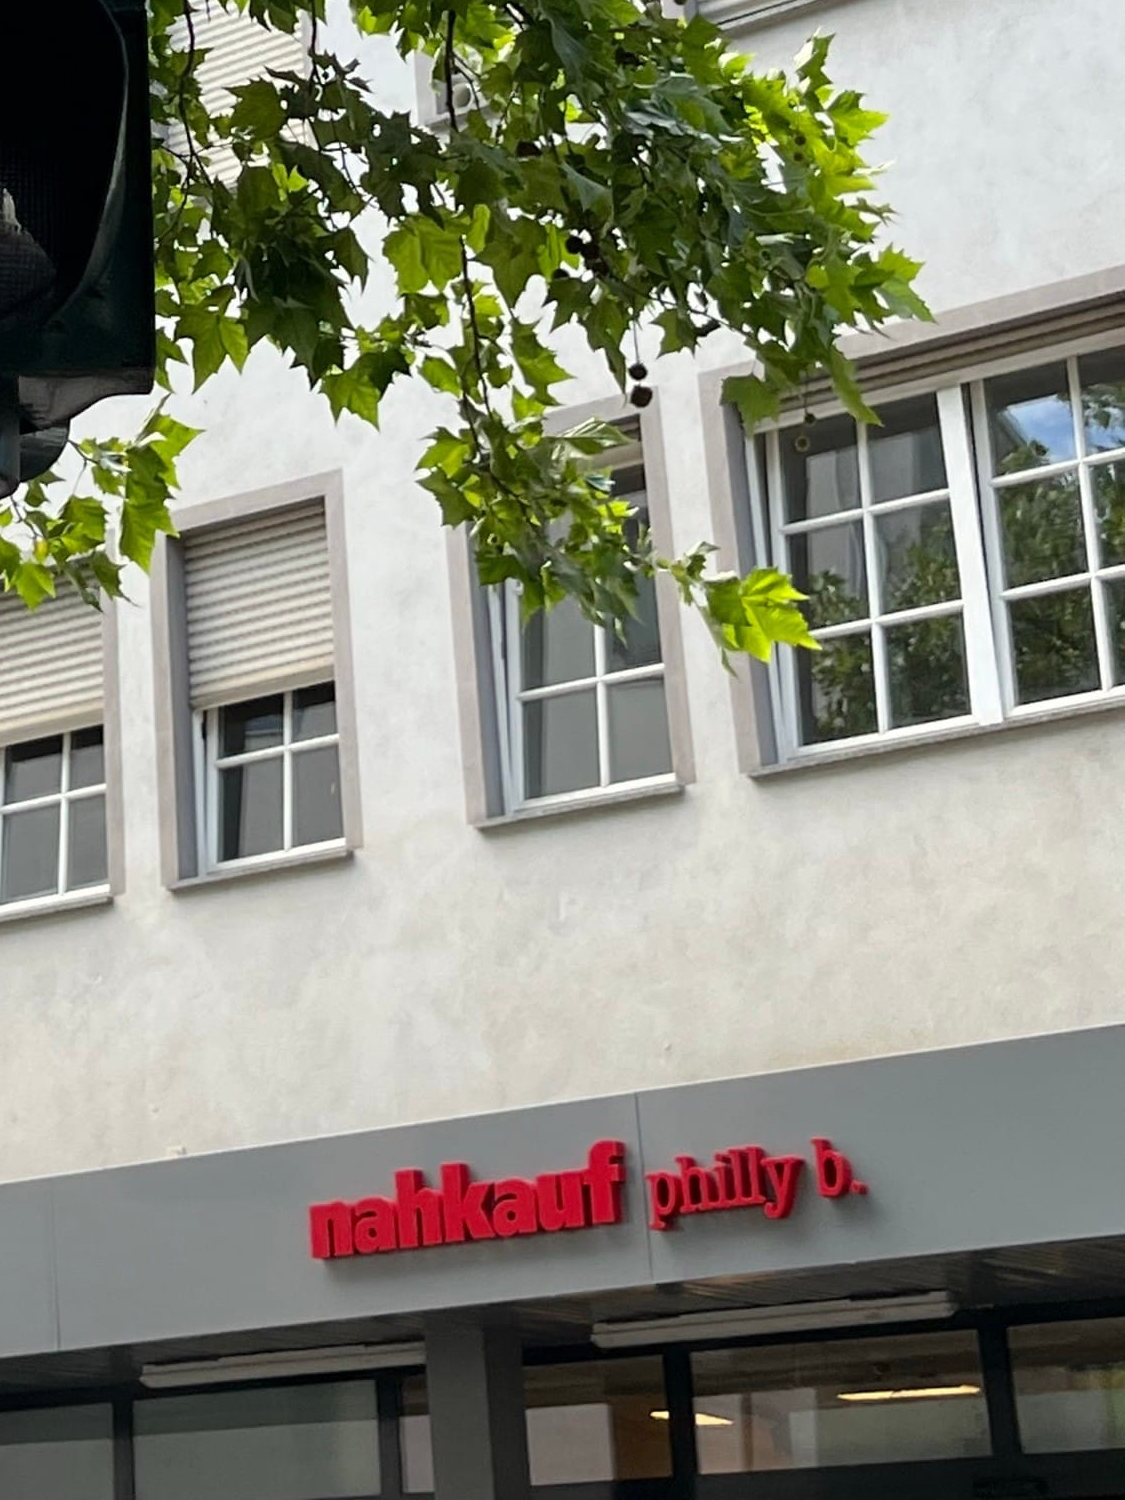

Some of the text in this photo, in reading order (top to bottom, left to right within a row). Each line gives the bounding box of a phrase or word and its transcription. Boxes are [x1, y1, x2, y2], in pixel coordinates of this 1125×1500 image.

[309, 1137, 868, 1260] nahkauf philly b.
